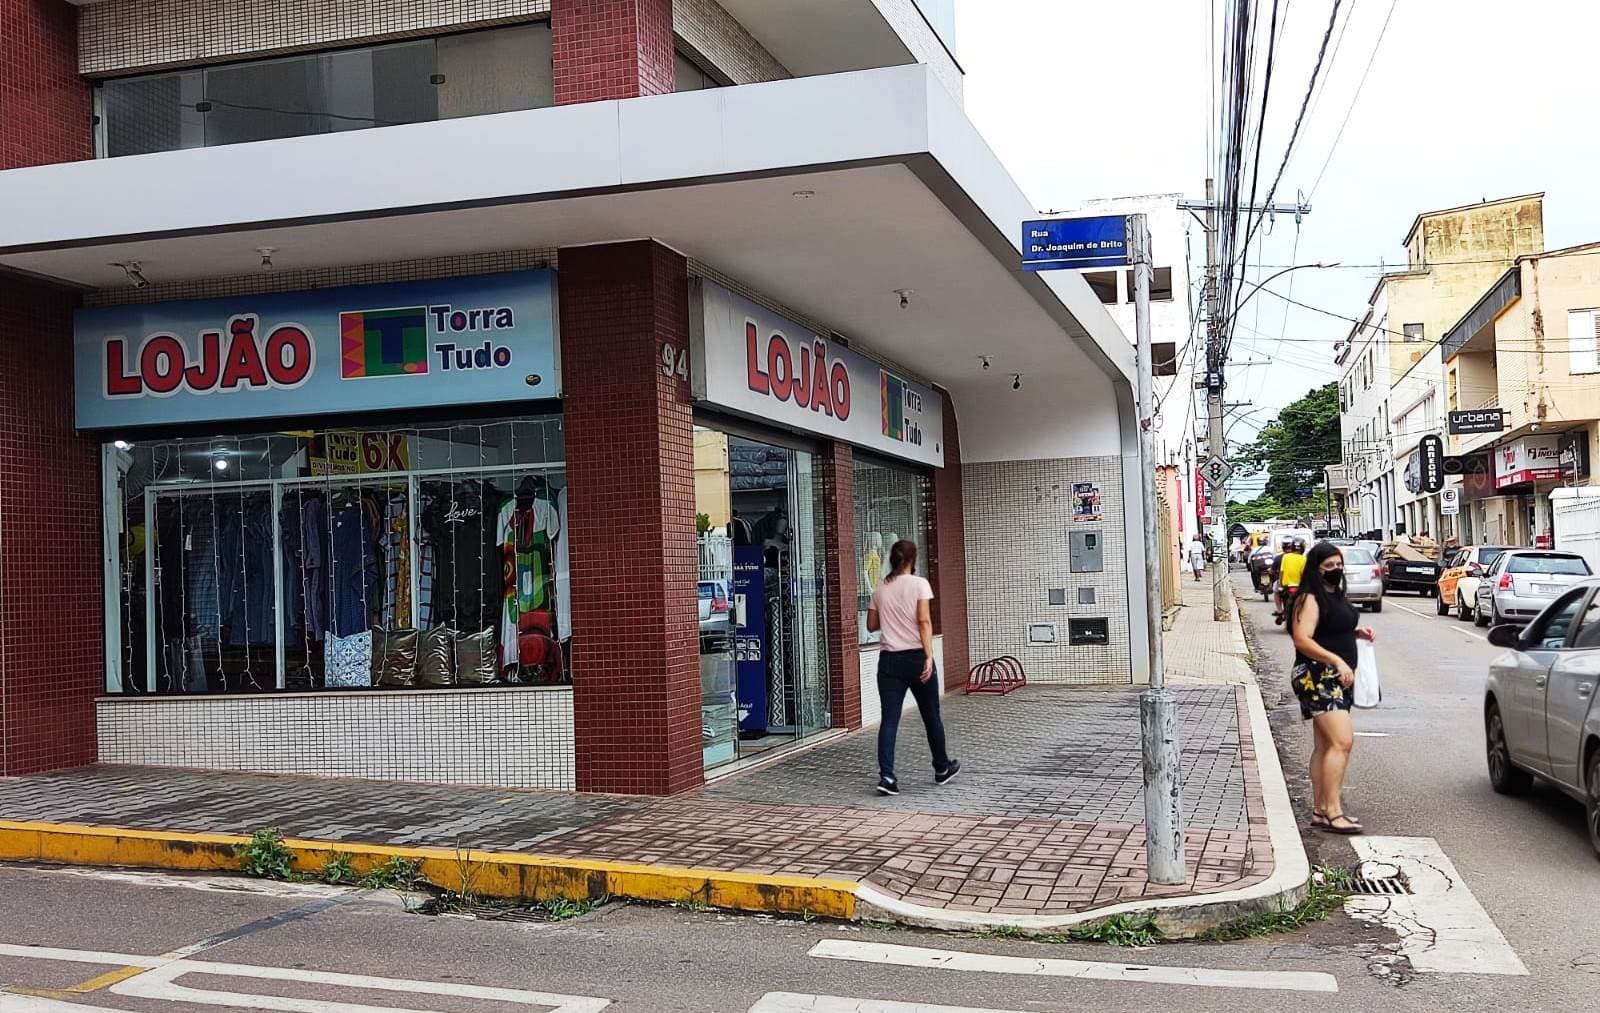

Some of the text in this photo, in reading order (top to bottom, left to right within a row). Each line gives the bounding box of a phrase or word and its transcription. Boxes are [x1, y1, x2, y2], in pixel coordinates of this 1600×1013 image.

[1031, 230, 1049, 238] Rua
[1046, 242, 1084, 253] Joaquim
[1086, 241, 1098, 249] de
[1100, 240, 1123, 248] Brito
[429, 304, 514, 333] Torra
[105, 315, 313, 397] LOJÃO
[435, 340, 512, 372] Tudo
[661, 343, 689, 382] 94
[745, 320, 851, 422] LOJÃO
[902, 381, 922, 413] Torra
[904, 420, 922, 447] Tudo
[1452, 412, 1500, 423] urbana
[329, 446, 357, 461] Tudo
[362, 432, 405, 470] 6X
[1425, 439, 1437, 489] MARECHAL
